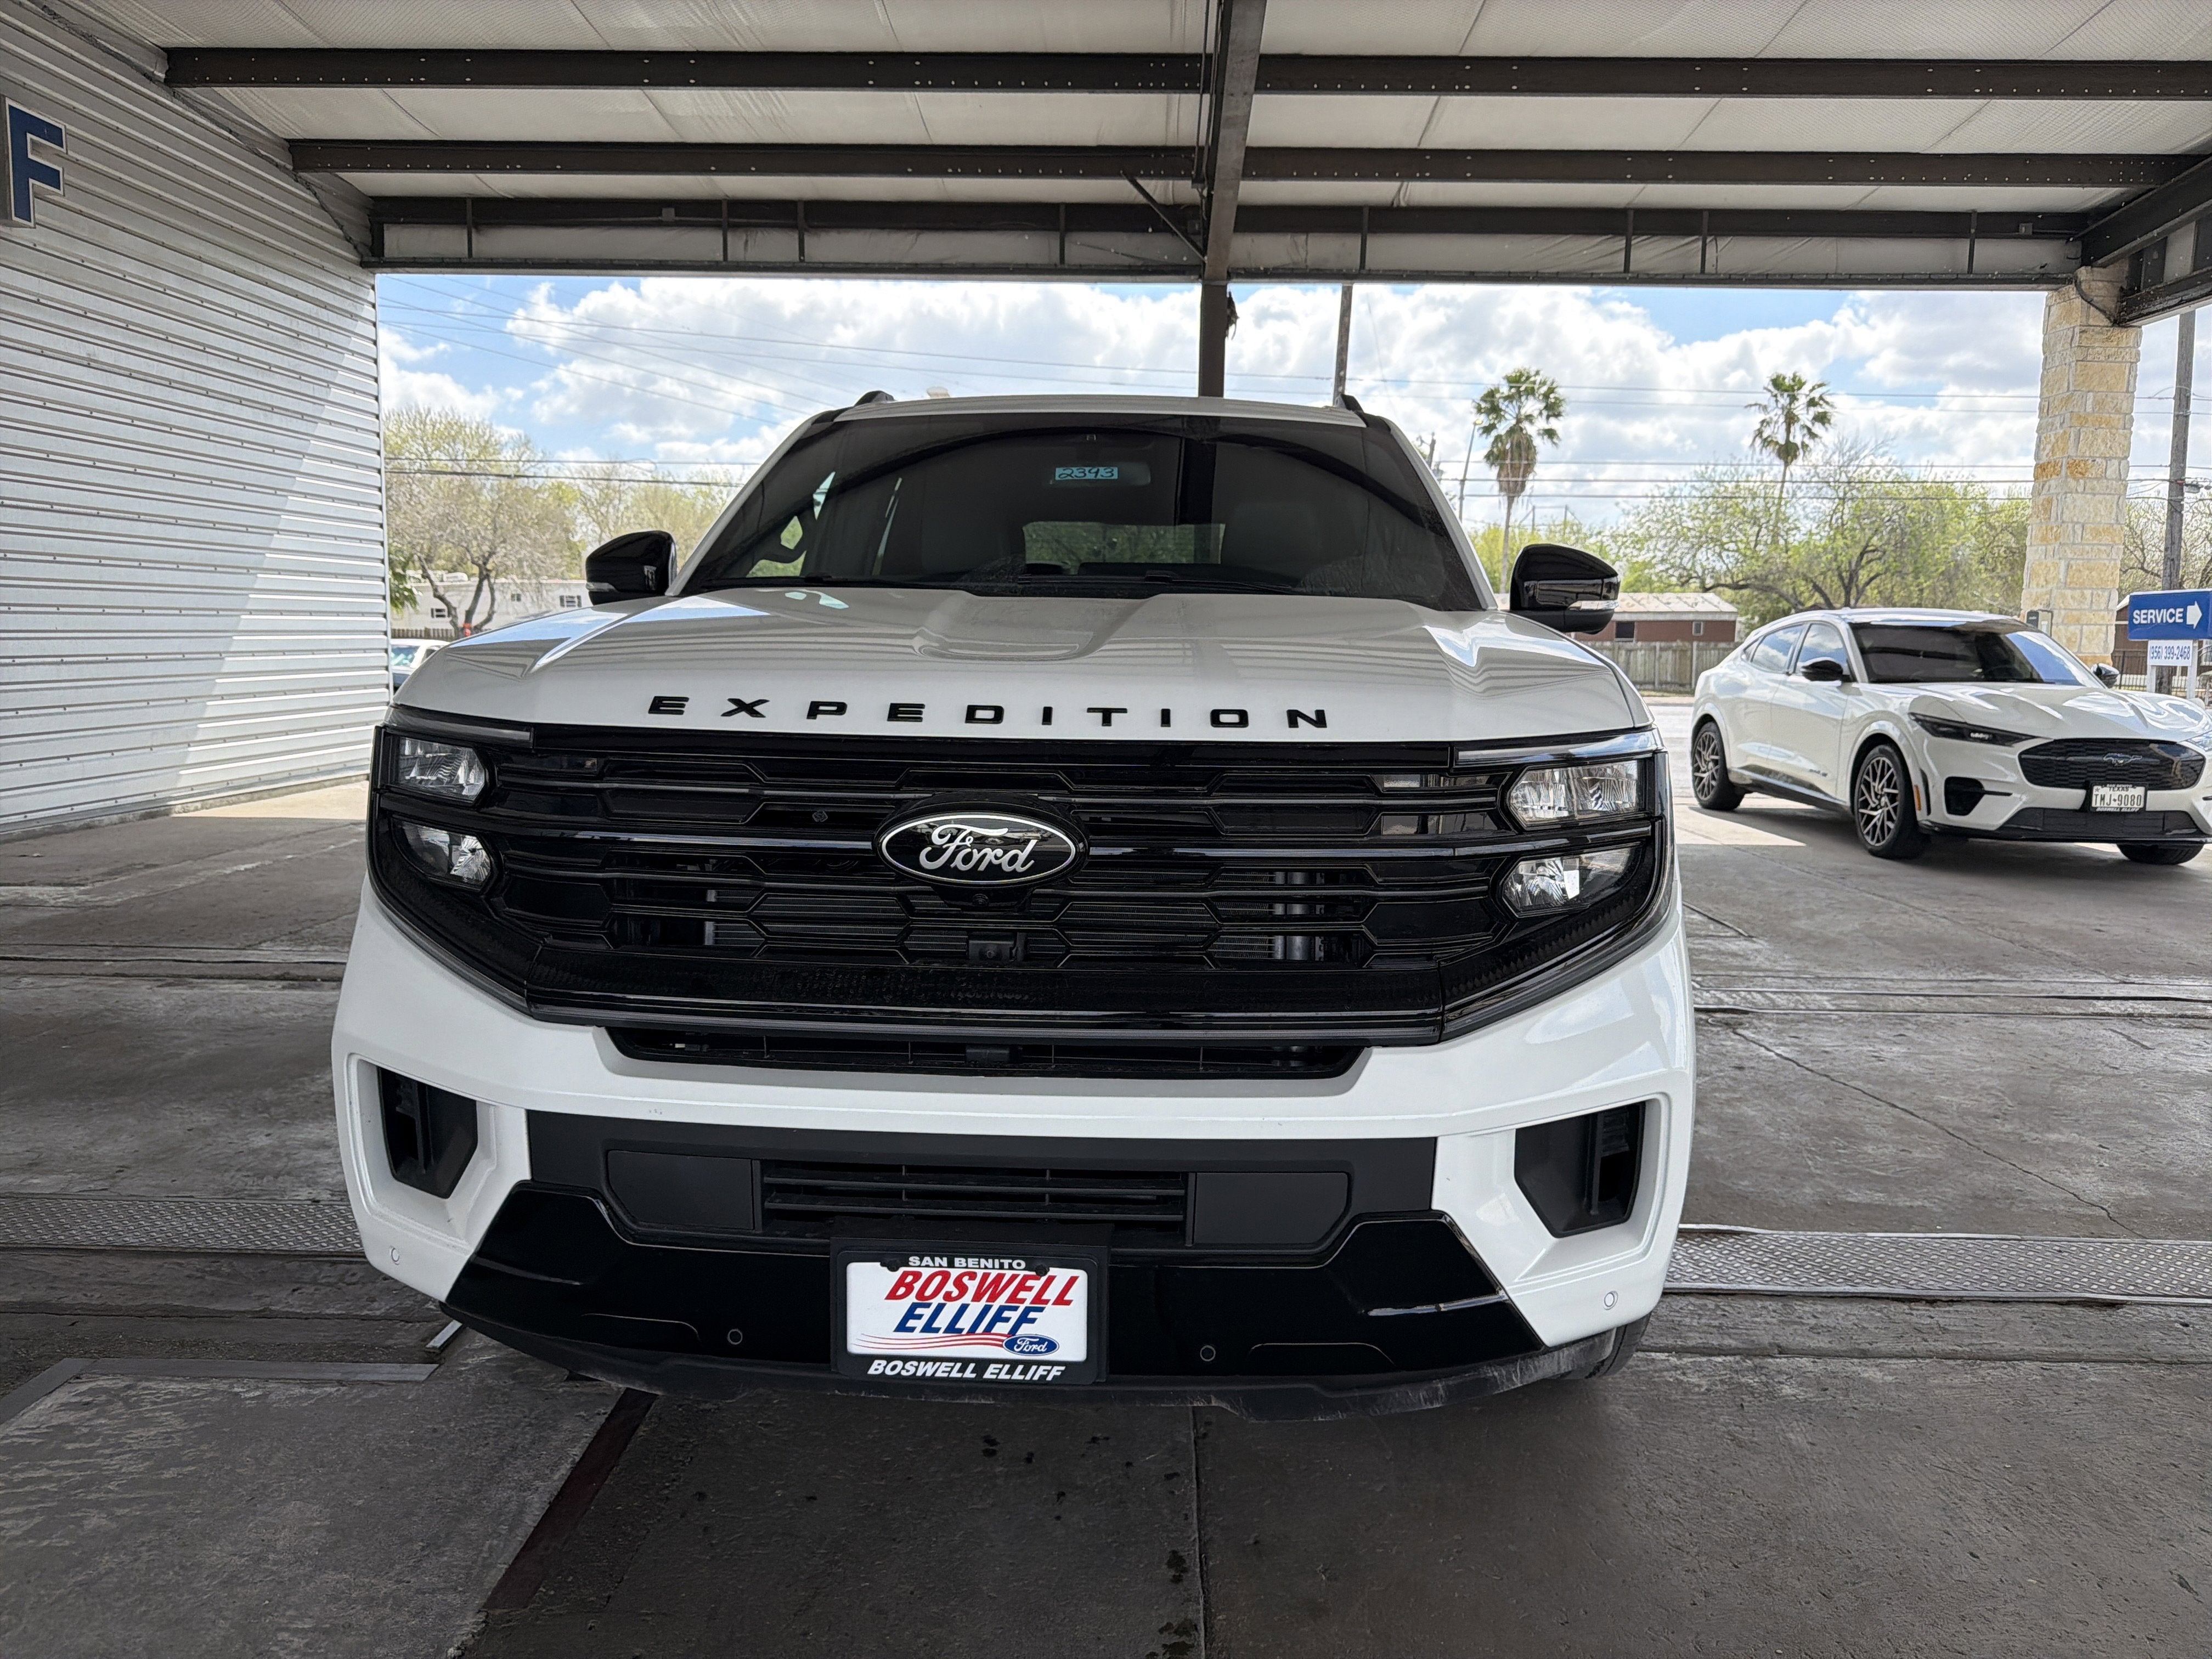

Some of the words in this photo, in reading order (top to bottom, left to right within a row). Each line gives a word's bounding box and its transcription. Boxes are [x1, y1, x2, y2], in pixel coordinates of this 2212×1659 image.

[5, 97, 67, 227] F
[2132, 608, 2184, 624] SERVICE
[2149, 646, 2163, 660] (956)
[2164, 645, 2191, 660] 399-2468
[648, 696, 1328, 729] EXPEDITION
[919, 823, 1036, 874] Ford
[908, 1256, 949, 1267] SAN
[953, 1257, 1026, 1269] BENITO
[884, 1269, 1079, 1306] BOSWELL
[893, 1302, 1047, 1336] ELLIFF
[1013, 1337, 1047, 1353] Ford
[867, 1359, 977, 1379] BOSWELL
[983, 1365, 1066, 1381] ELLIFF
